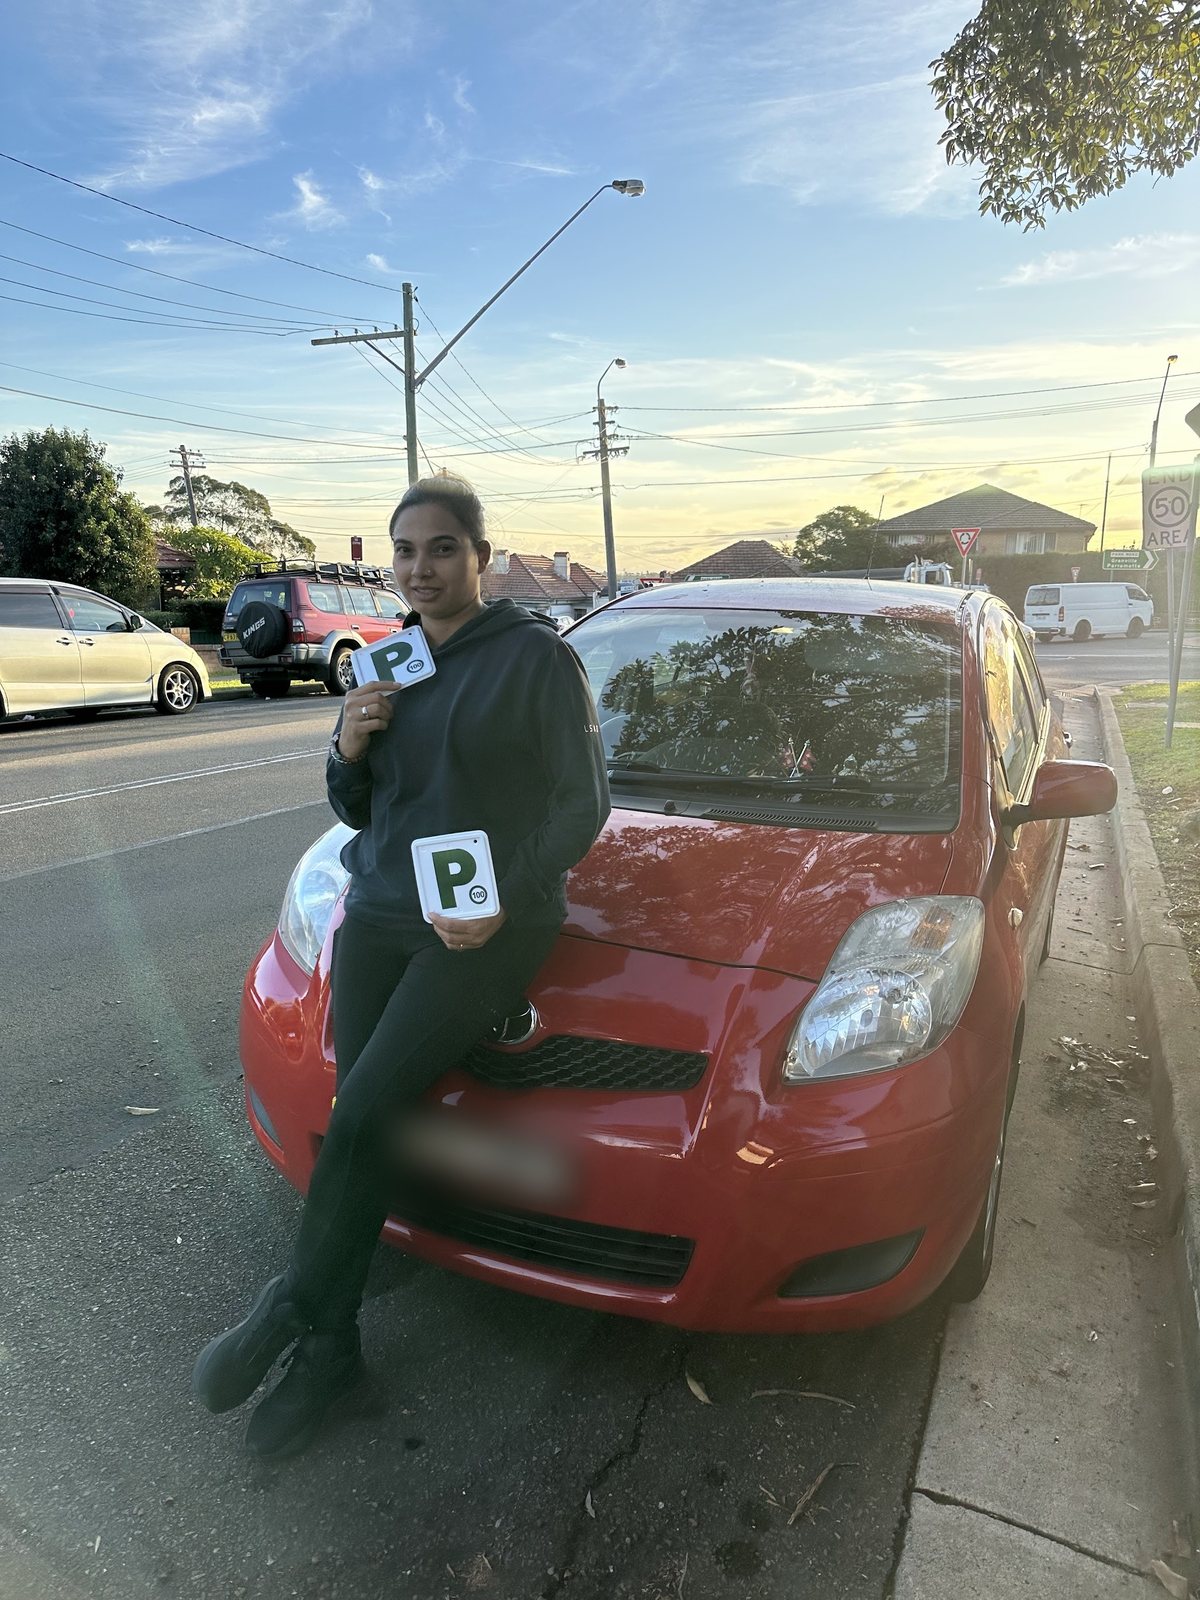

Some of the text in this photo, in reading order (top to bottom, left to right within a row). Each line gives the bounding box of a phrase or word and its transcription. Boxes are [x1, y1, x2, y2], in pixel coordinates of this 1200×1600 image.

[1155, 496, 1185, 518] 50
[243, 617, 266, 639] KINGS
[370, 641, 413, 682] P
[409, 662, 422, 670] 100
[432, 848, 477, 910] P
[472, 890, 485, 899] 100
